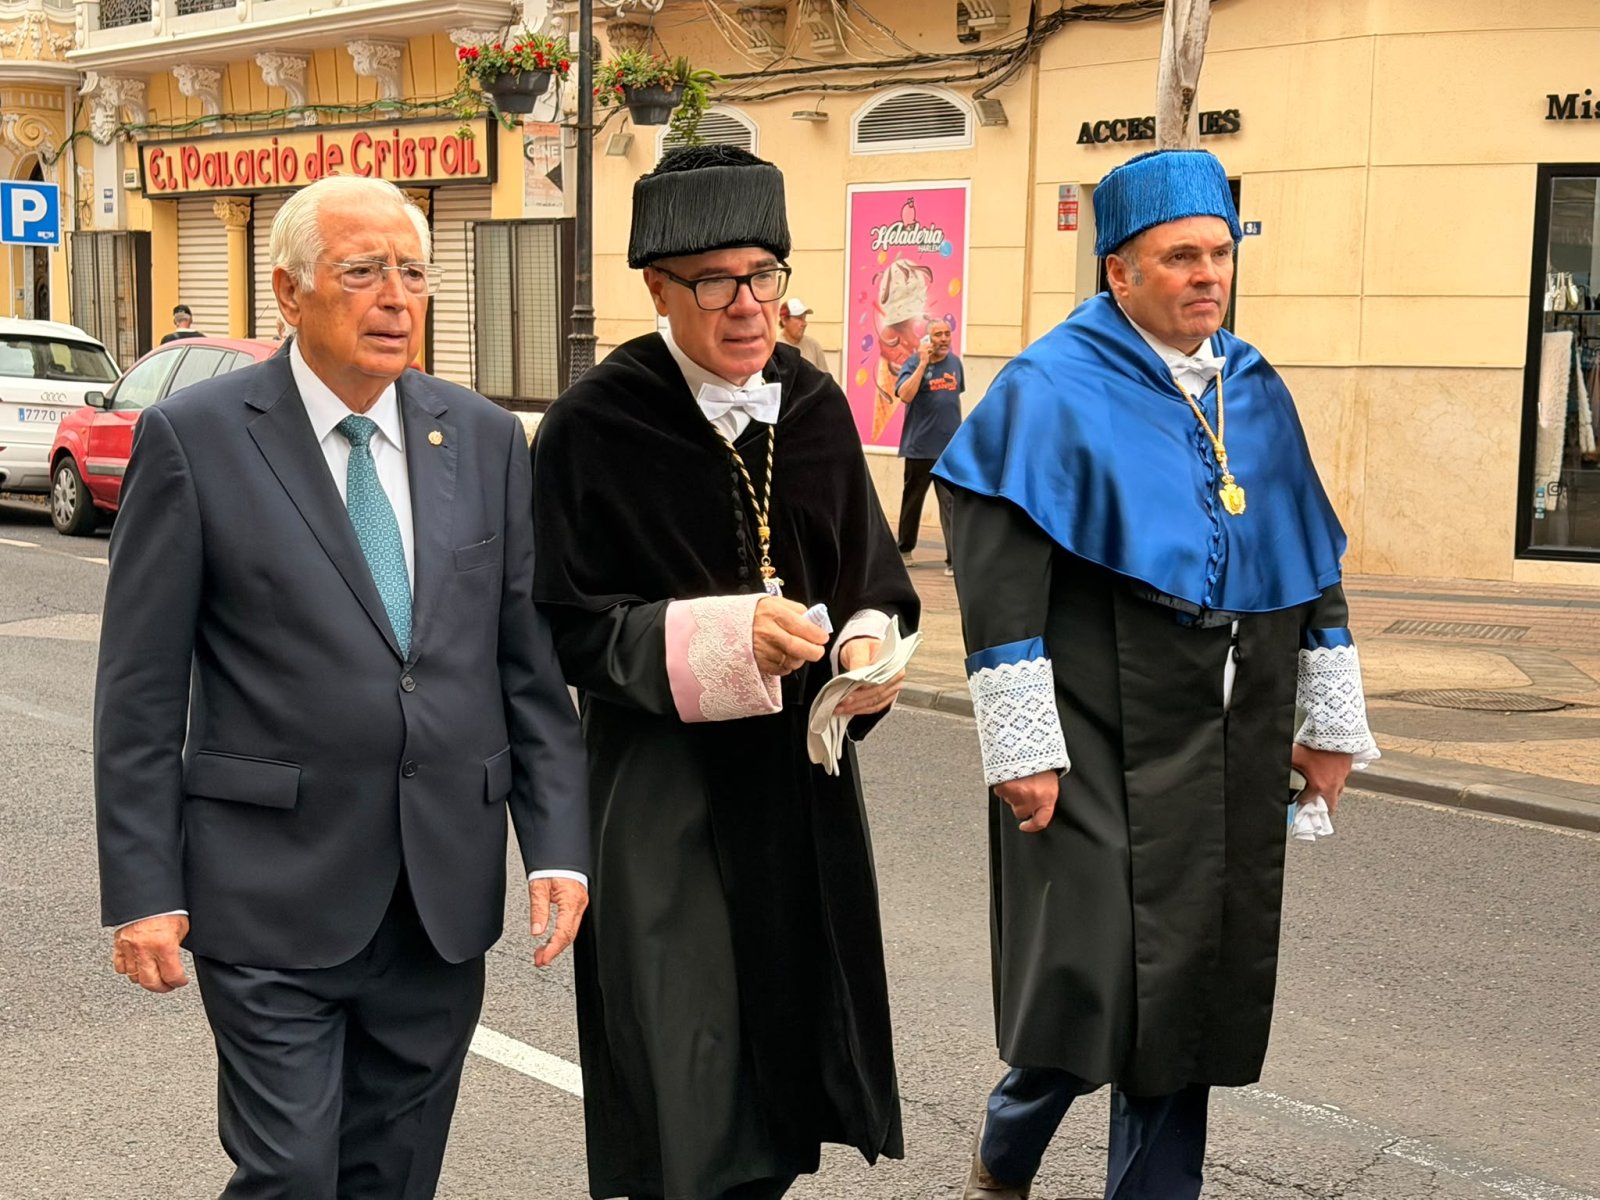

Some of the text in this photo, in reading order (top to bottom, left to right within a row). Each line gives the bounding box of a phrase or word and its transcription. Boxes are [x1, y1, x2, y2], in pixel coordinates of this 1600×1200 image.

[1077, 108, 1241, 144] ACCESIES
[303, 134, 345, 180] de
[11, 188, 48, 237] P
[25, 408, 56, 422] 7770
